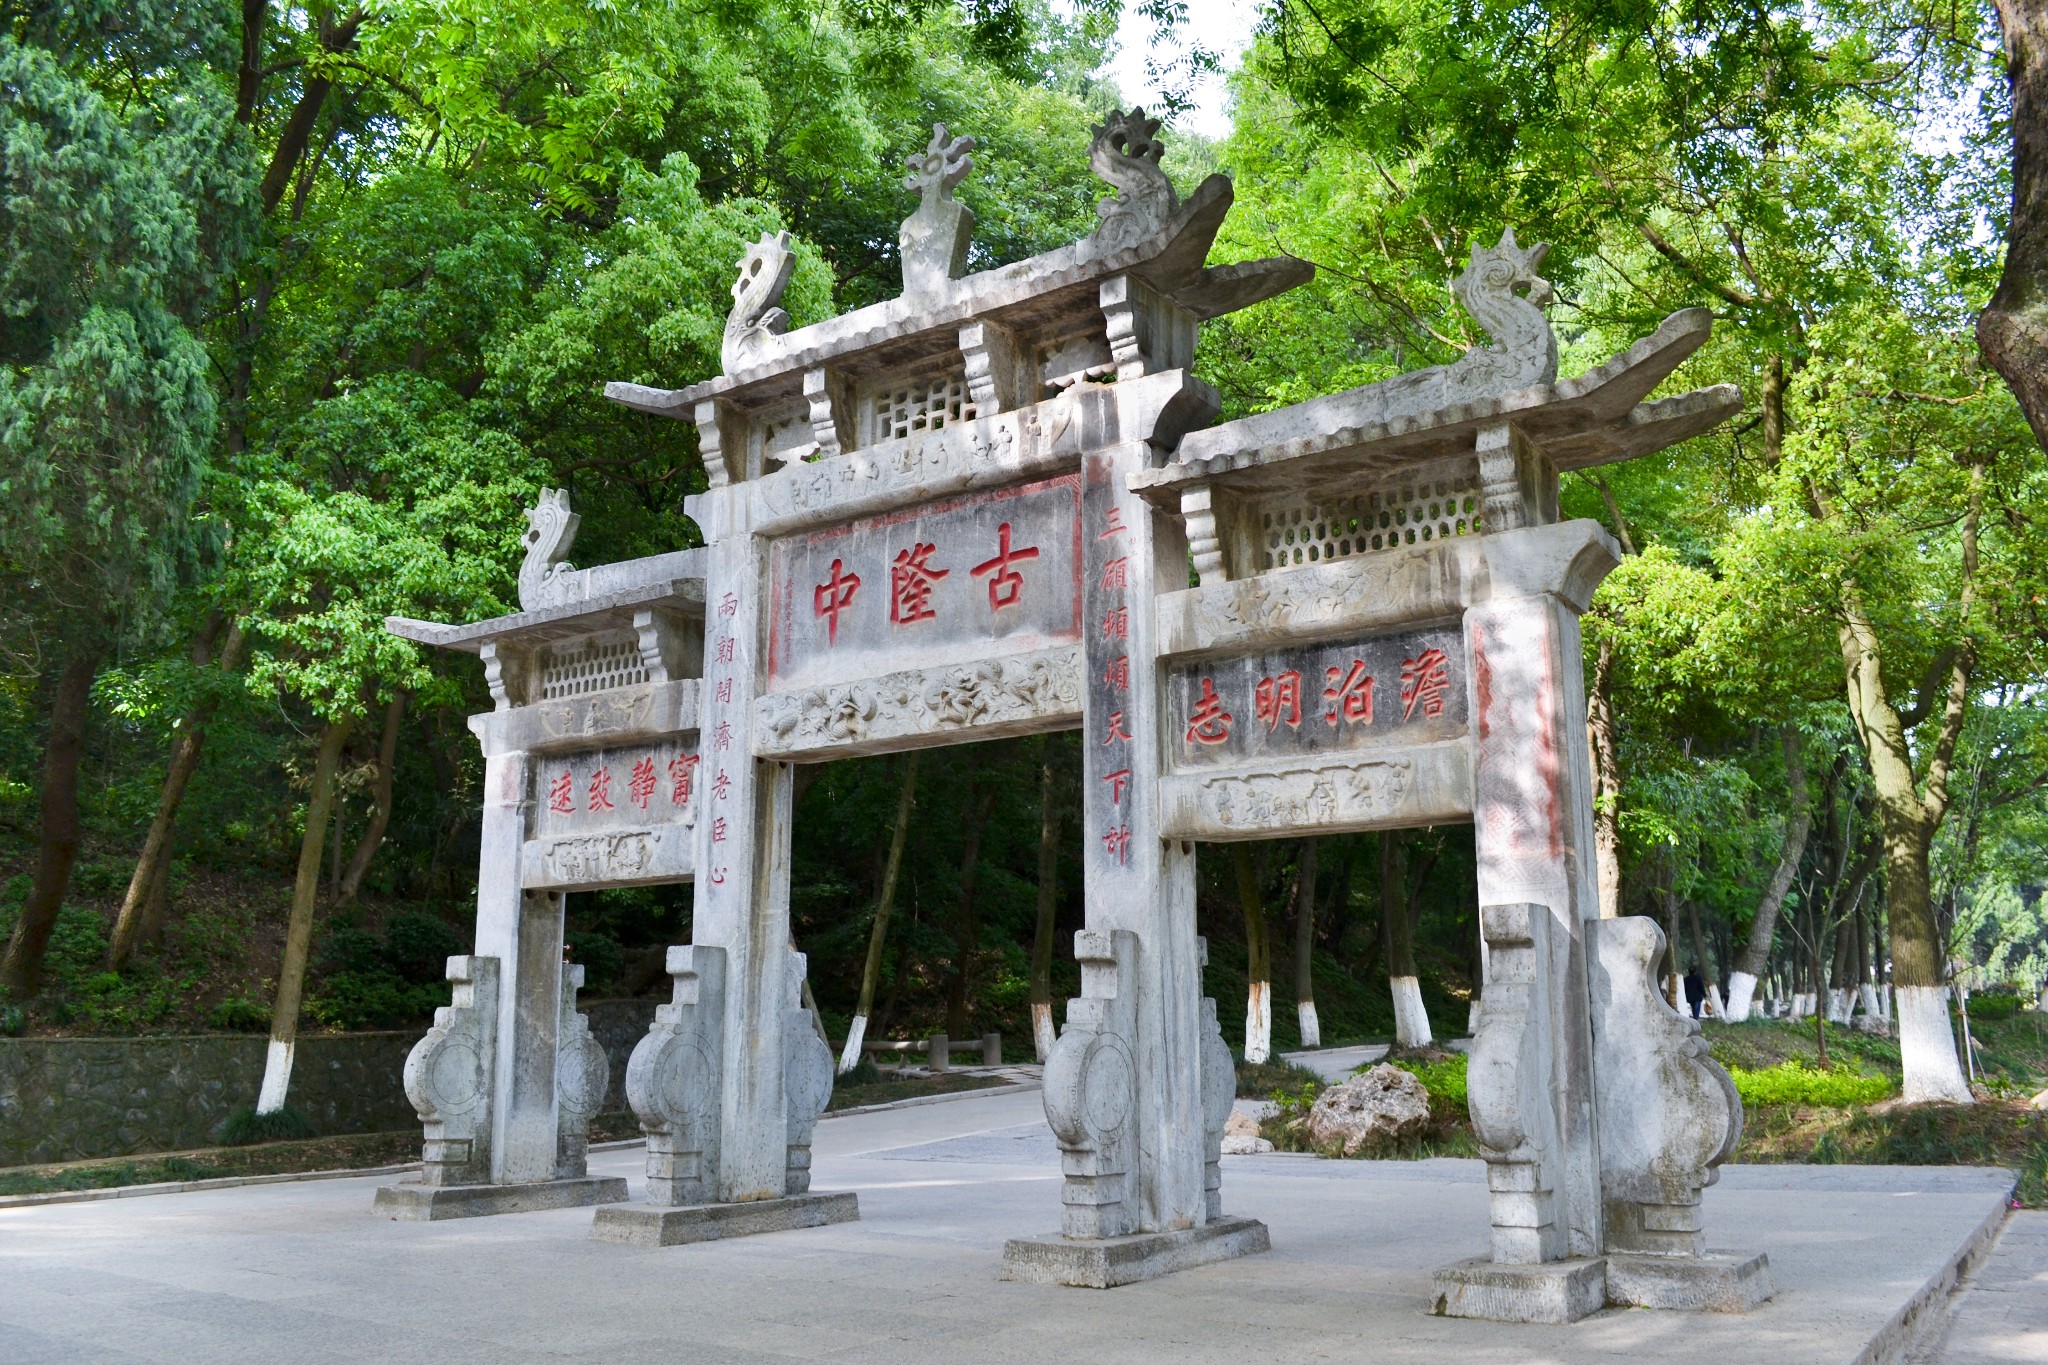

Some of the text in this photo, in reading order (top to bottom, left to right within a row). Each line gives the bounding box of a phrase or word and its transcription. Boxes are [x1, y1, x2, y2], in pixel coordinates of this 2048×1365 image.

[813, 522, 1039, 647] 古隆中
[1186, 648, 1450, 745] 澹泊明志
